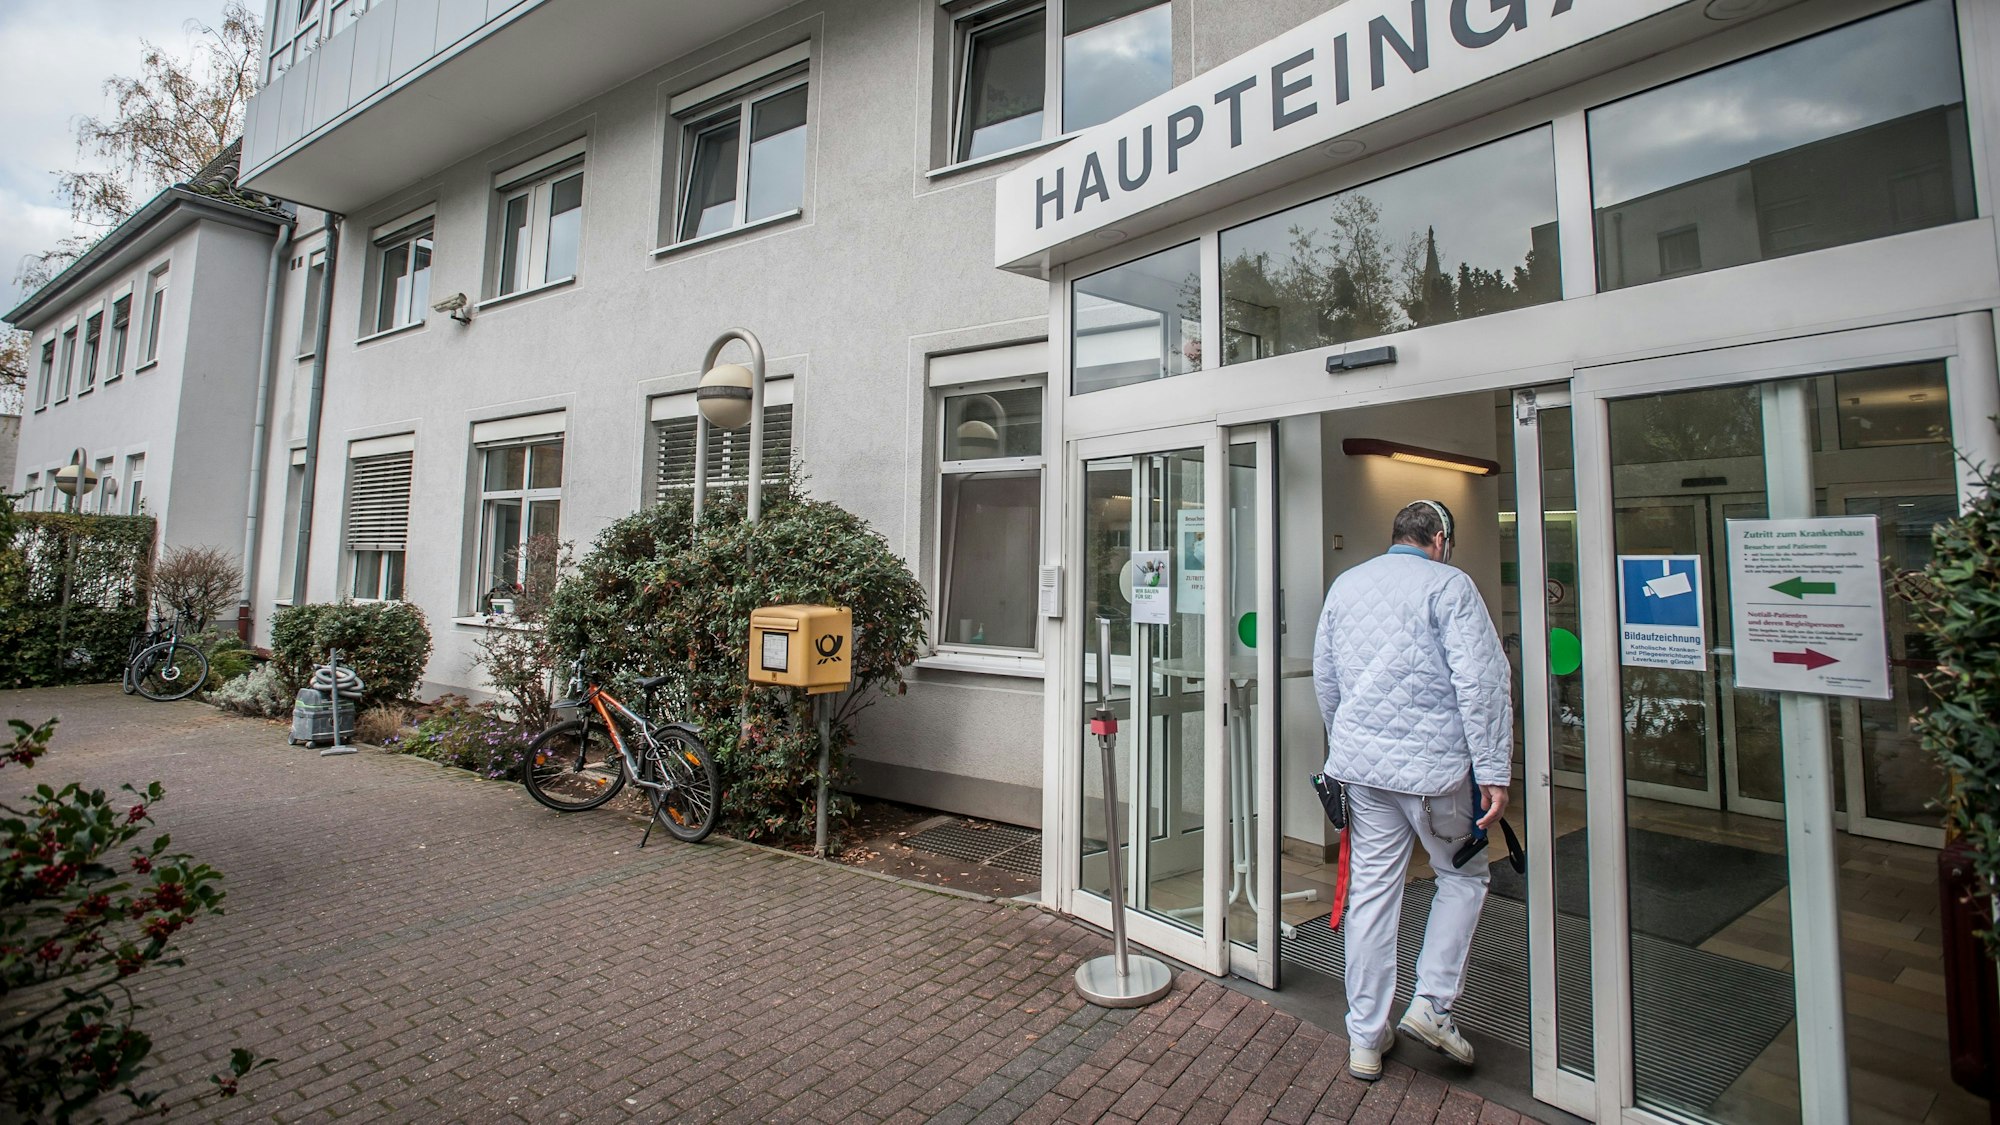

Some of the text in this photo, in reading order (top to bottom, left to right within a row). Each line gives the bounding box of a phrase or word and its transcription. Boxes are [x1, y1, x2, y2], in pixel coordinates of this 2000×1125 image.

[1035, 0, 1574, 229] HAUPTEING
[1743, 531, 1774, 539] Zutritt
[1799, 529, 1865, 538] Krankenhaus
[1748, 611, 1808, 619] Notfall-Patienten
[1785, 620, 1845, 629] Begleitpersonen
[1624, 631, 1701, 645] Bildaufzeichnung
[1632, 656, 1668, 664] Leverkusen
[1639, 651, 1702, 660] Pflegeeinrichtungen
